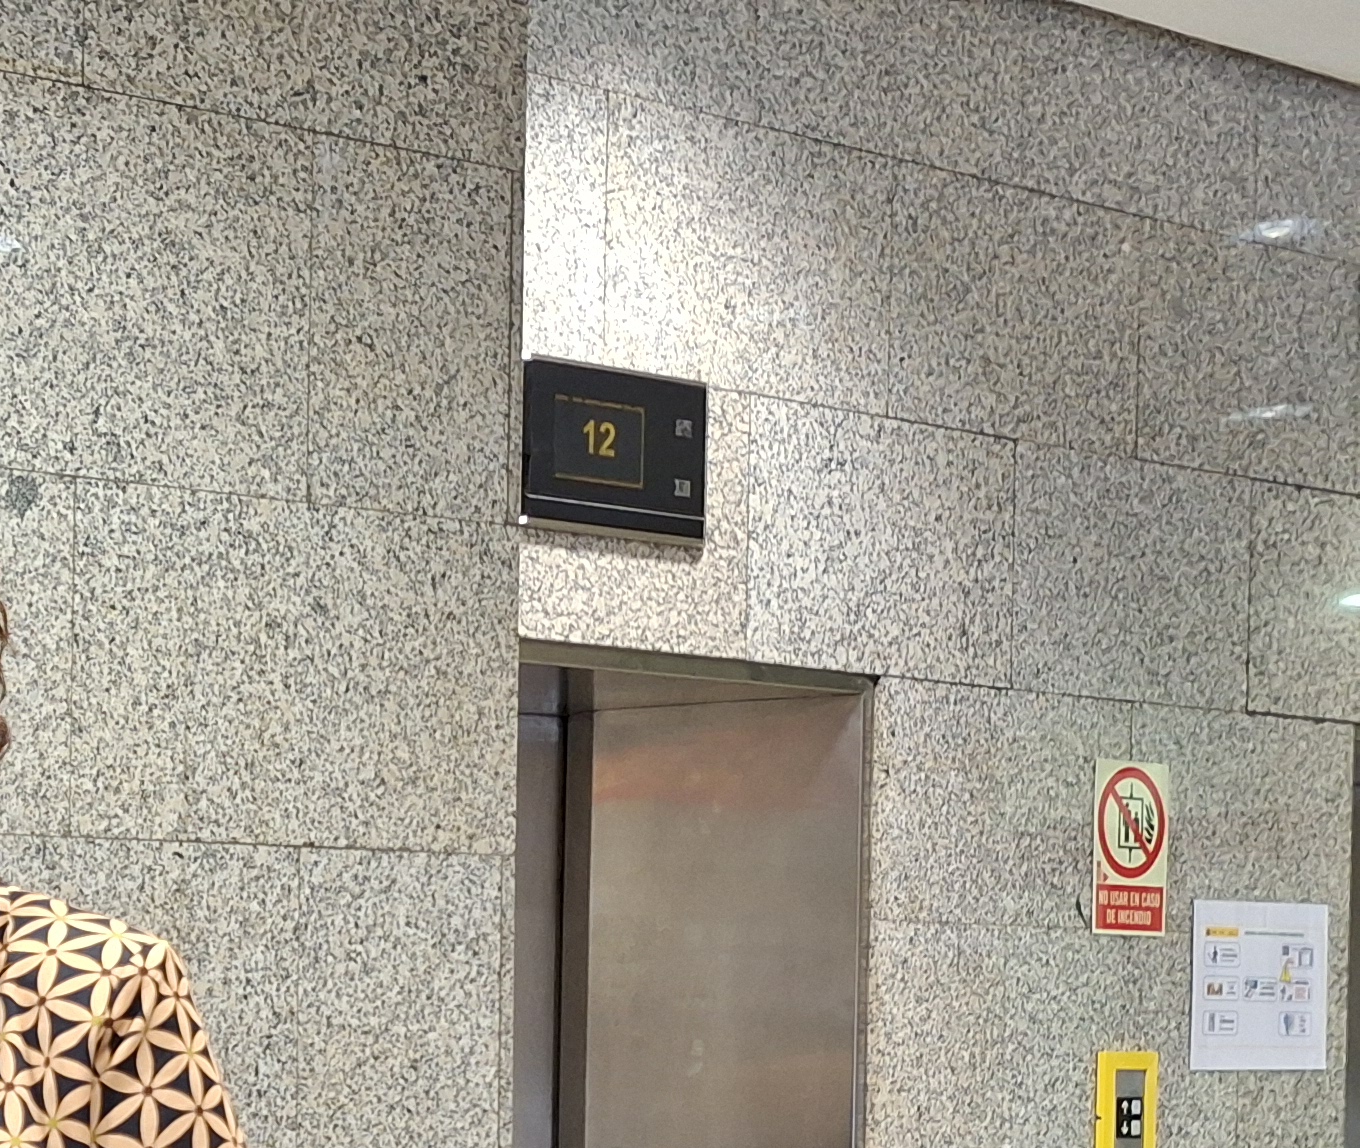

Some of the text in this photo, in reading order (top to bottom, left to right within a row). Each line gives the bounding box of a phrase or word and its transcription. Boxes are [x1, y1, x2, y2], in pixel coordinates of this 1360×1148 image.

[583, 419, 616, 458] 12
[1098, 889, 1161, 908] NO USAR EN CASO
[1106, 908, 1152, 925] DE INCENDIO
